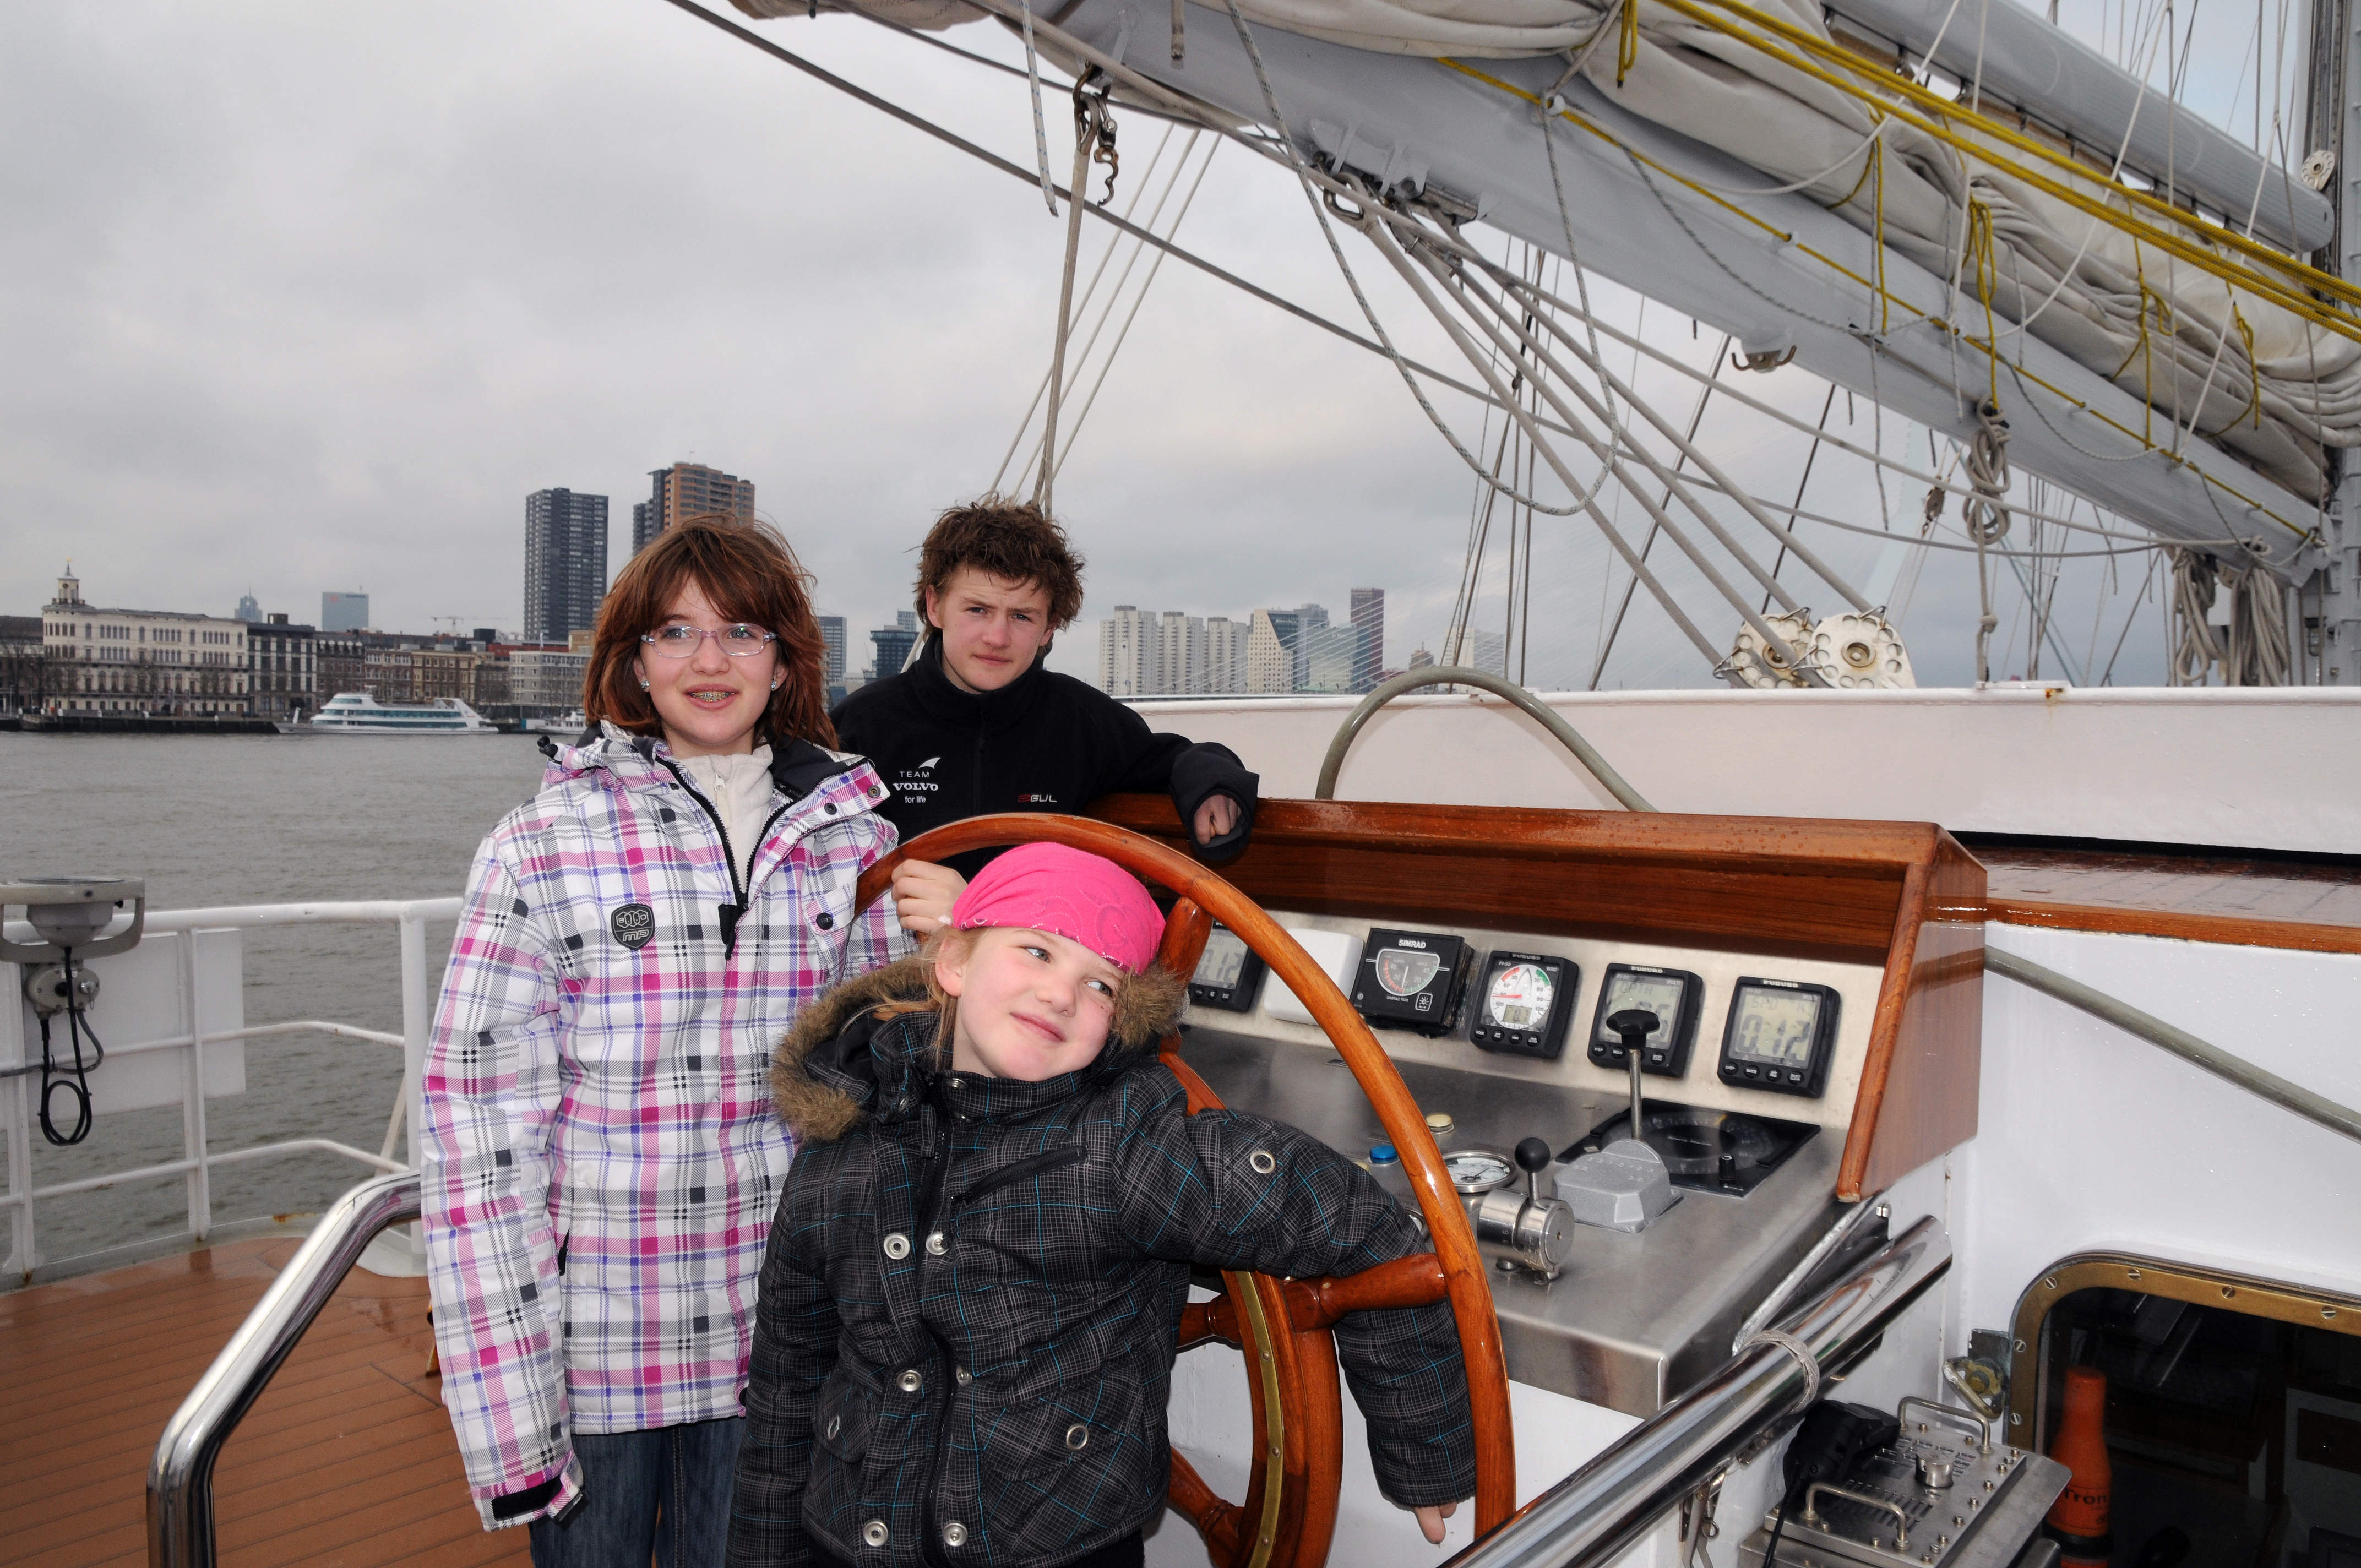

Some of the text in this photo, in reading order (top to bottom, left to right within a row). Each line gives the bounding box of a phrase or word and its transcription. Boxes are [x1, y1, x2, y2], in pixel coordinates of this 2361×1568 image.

[892, 782, 939, 791] VOLVO
[1030, 794, 1058, 803] GUL
[1399, 939, 1427, 949] SIMRAD
